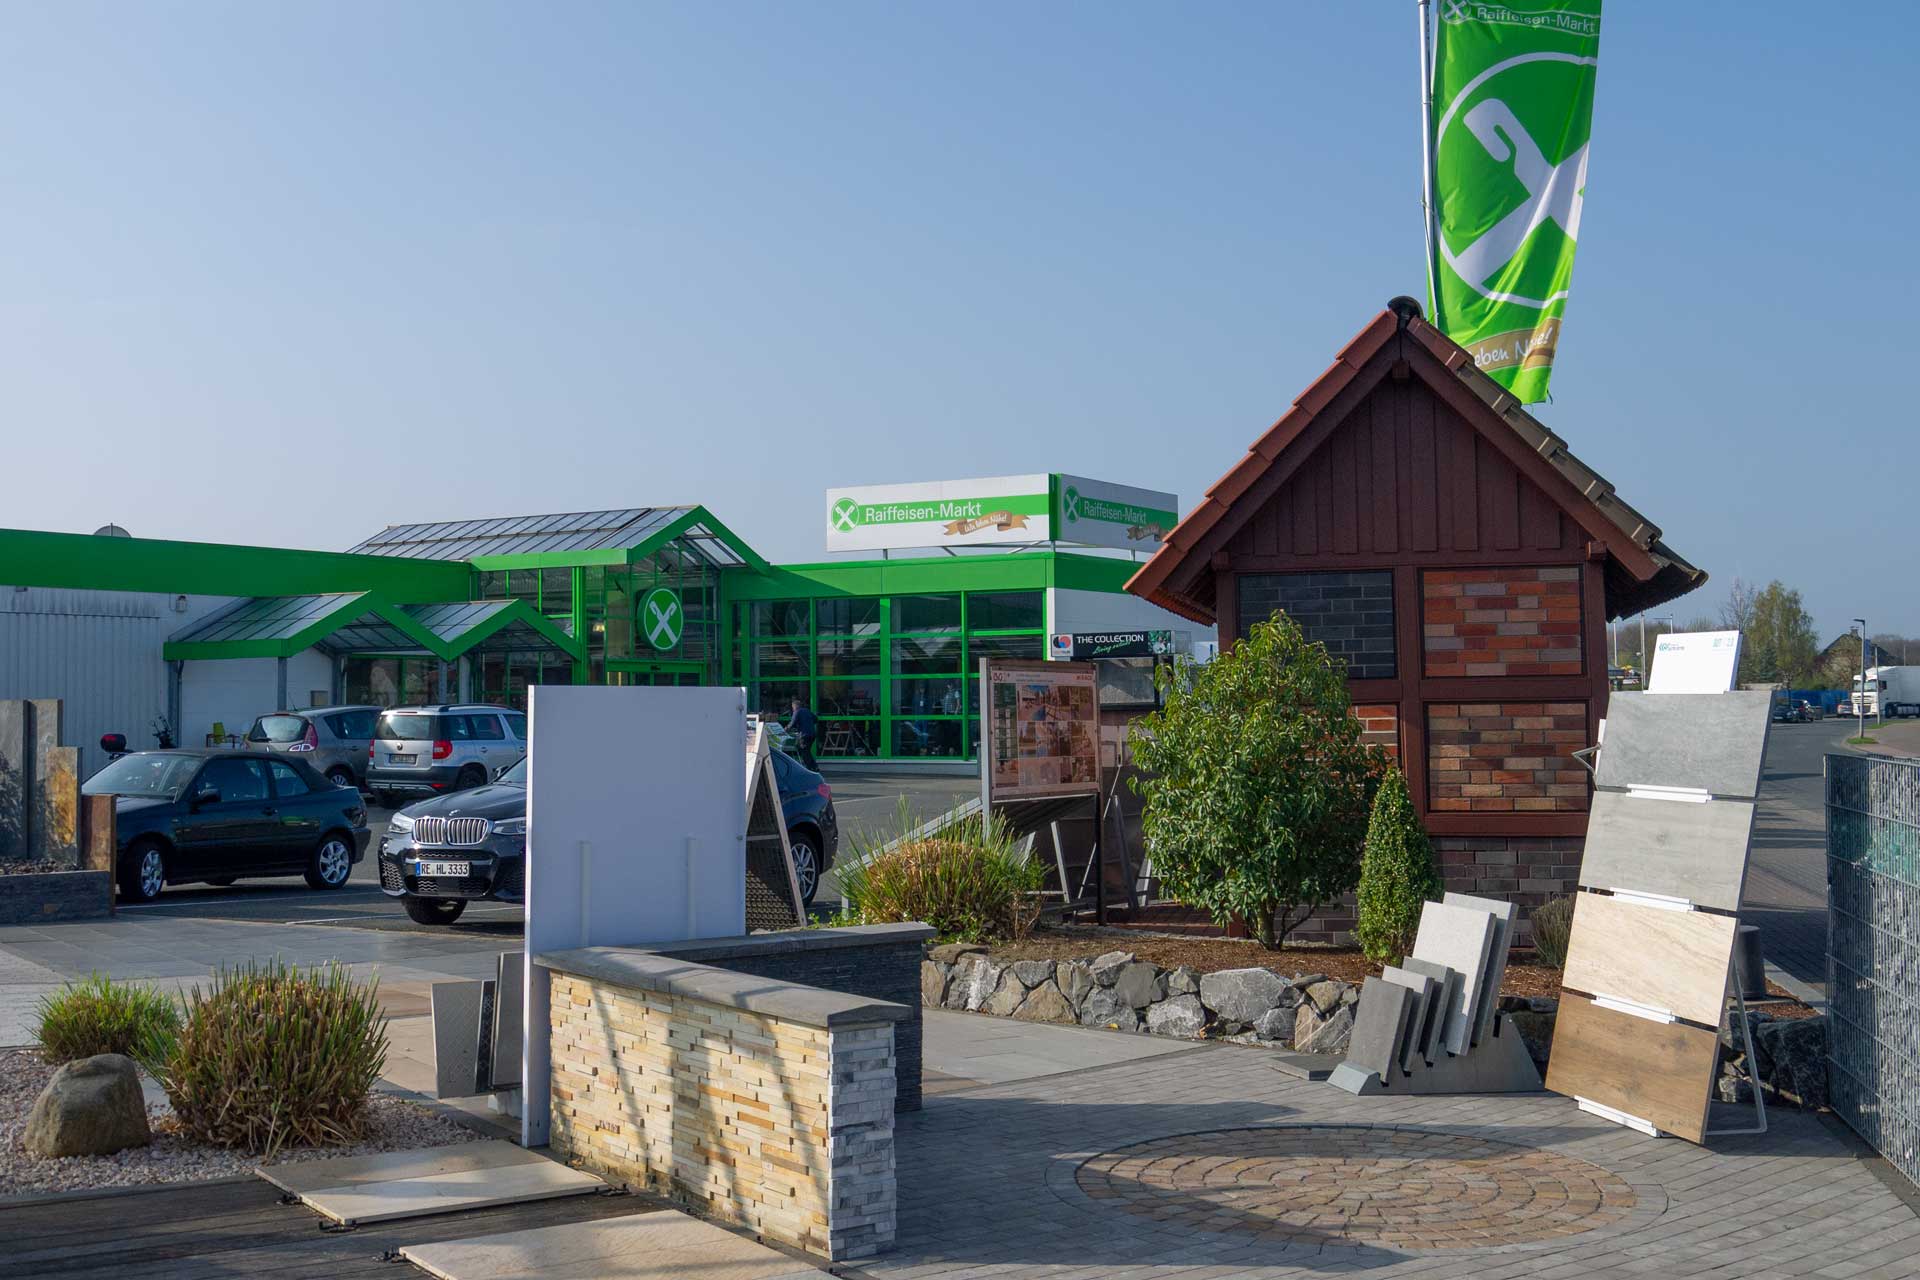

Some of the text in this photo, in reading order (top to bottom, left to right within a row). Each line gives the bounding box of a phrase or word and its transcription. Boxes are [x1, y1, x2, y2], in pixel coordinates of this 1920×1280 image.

[1477, 7, 1595, 33] Raiffeisen-Markt
[1469, 347, 1509, 367] eben
[865, 502, 982, 522] Raiffeisen-Markt
[1084, 500, 1147, 525] Raiffeisen-Markt
[1077, 634, 1144, 644] THE COLLECTION
[422, 864, 468, 874] RE HL 3333
